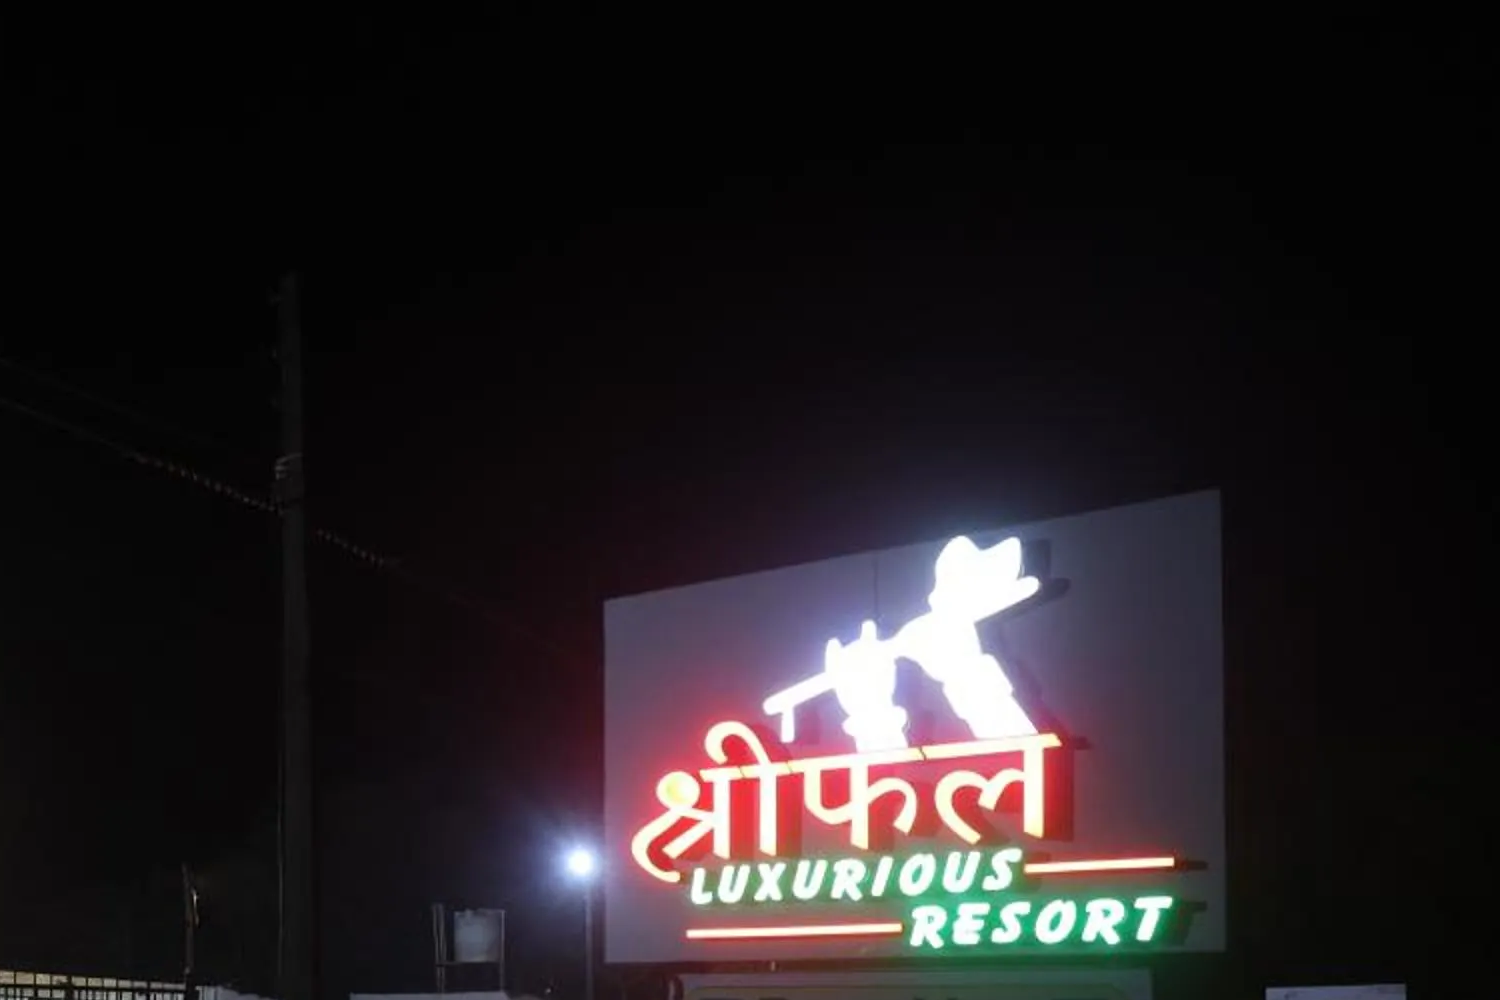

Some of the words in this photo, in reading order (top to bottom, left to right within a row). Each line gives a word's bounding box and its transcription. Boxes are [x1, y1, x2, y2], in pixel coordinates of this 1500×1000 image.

[631, 720, 1063, 883] श्रीफल
[690, 848, 1023, 906] LUXURIOUS
[910, 896, 1174, 949] RESORT
